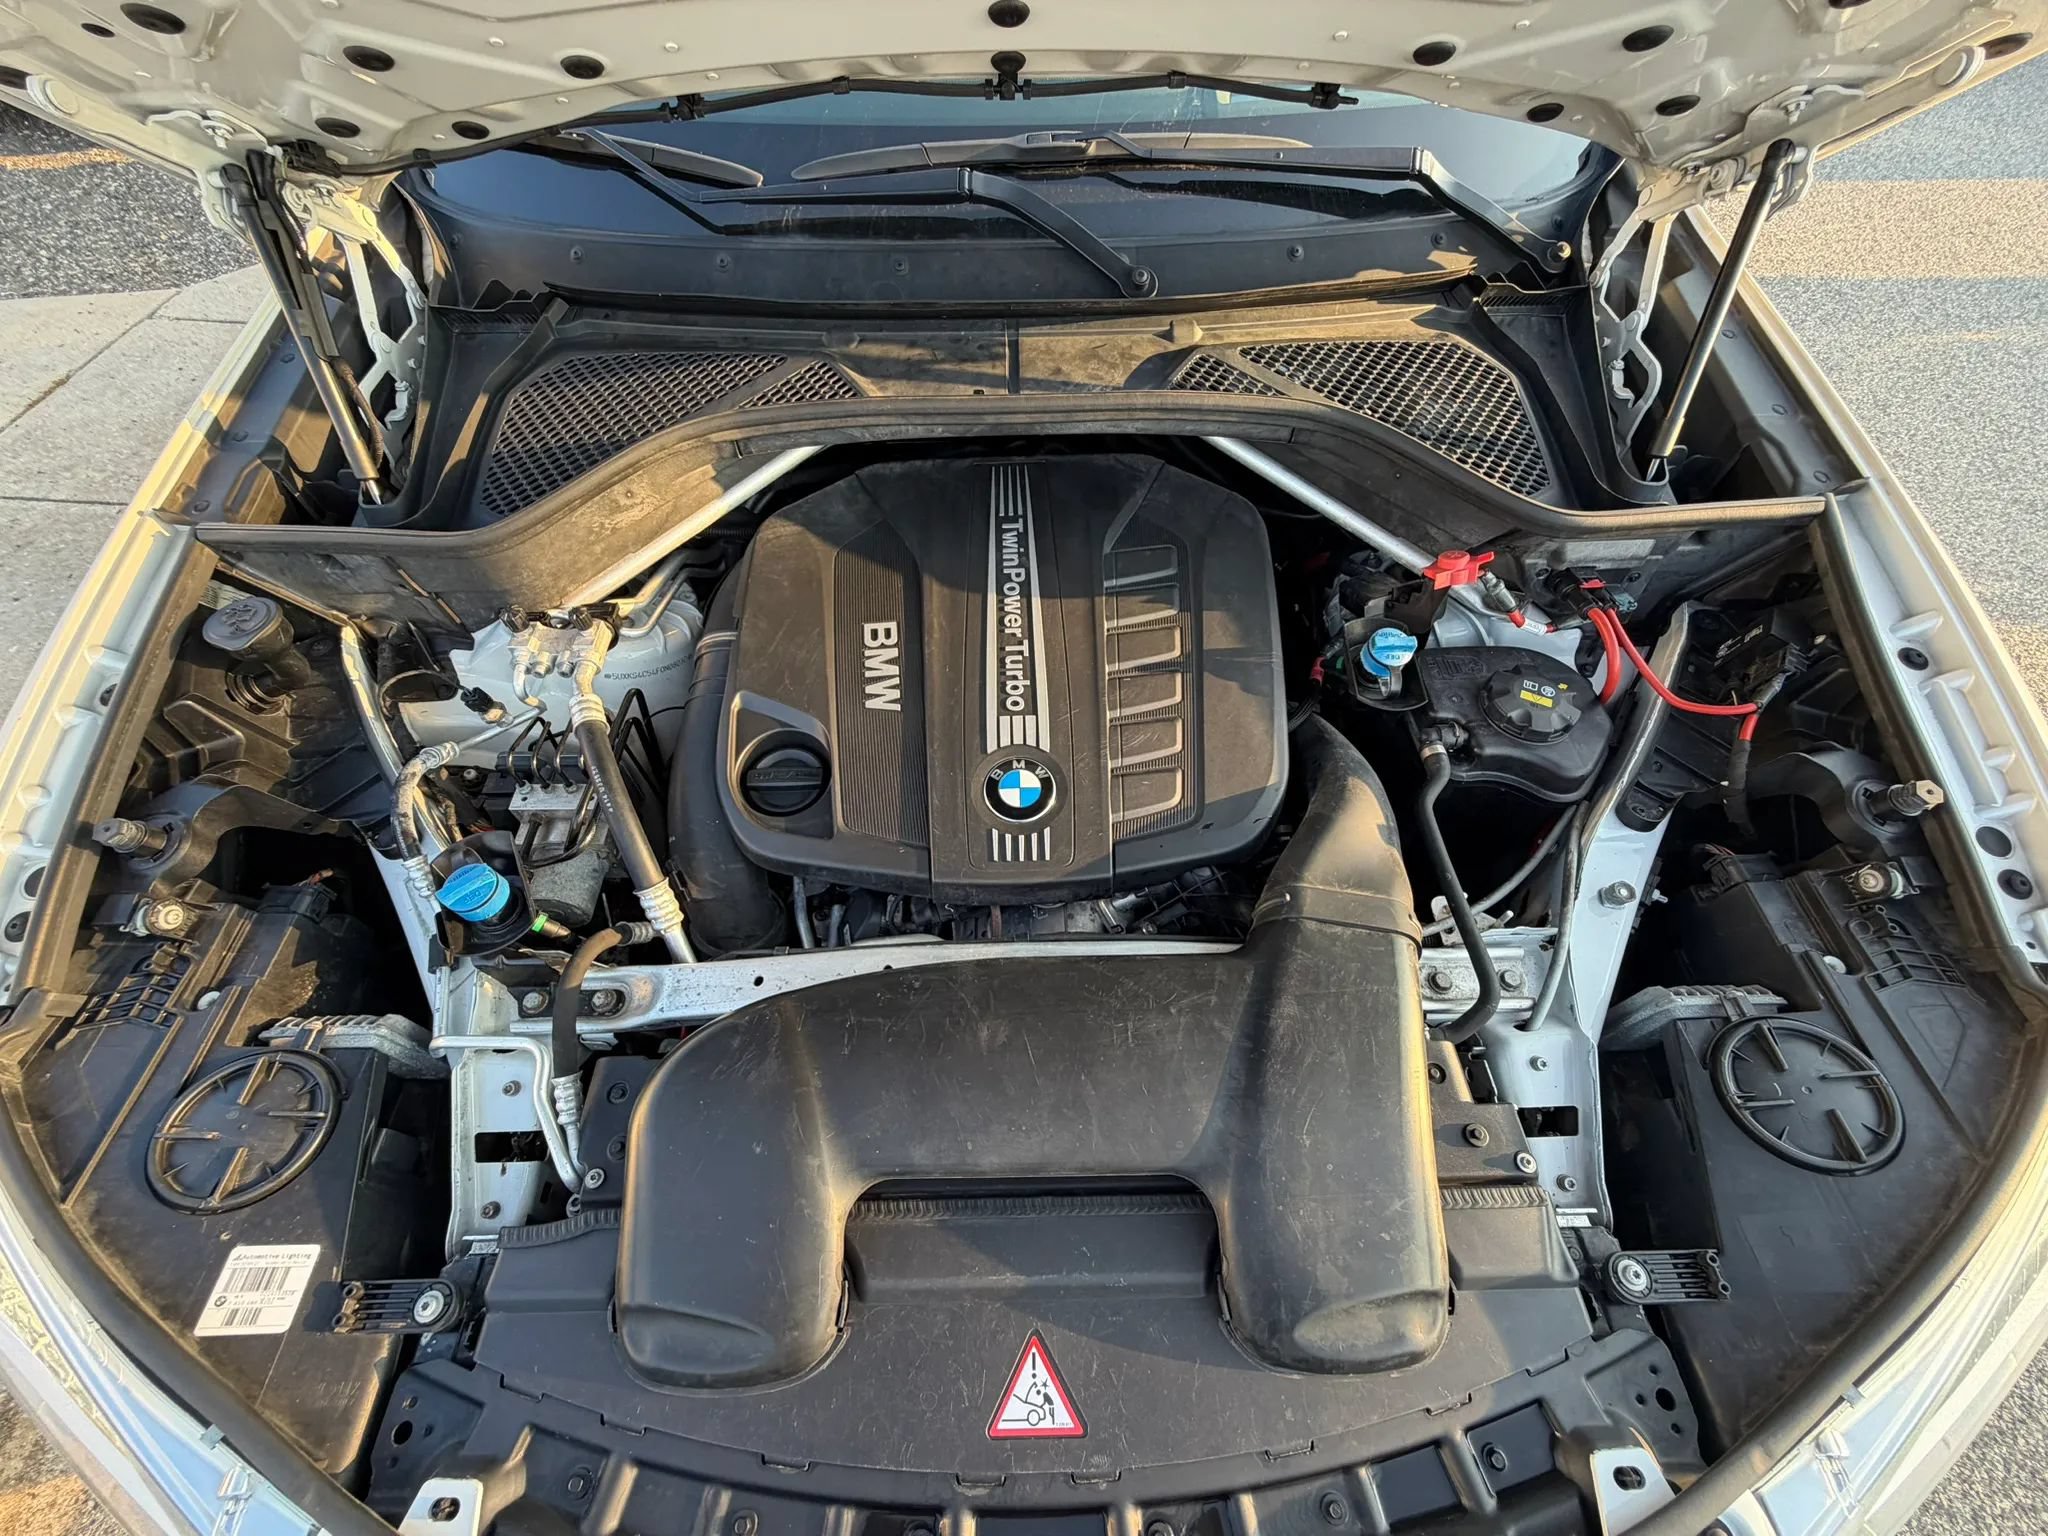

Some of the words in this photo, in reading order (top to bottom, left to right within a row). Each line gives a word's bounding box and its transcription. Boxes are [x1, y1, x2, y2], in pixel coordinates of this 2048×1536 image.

[1001, 517, 1026, 637] TwinPower
[863, 621, 901, 711] BMW
[1004, 639, 1031, 712] Turbo
[990, 759, 1050, 781] BMW
[281, 1252, 312, 1261] Lighting
